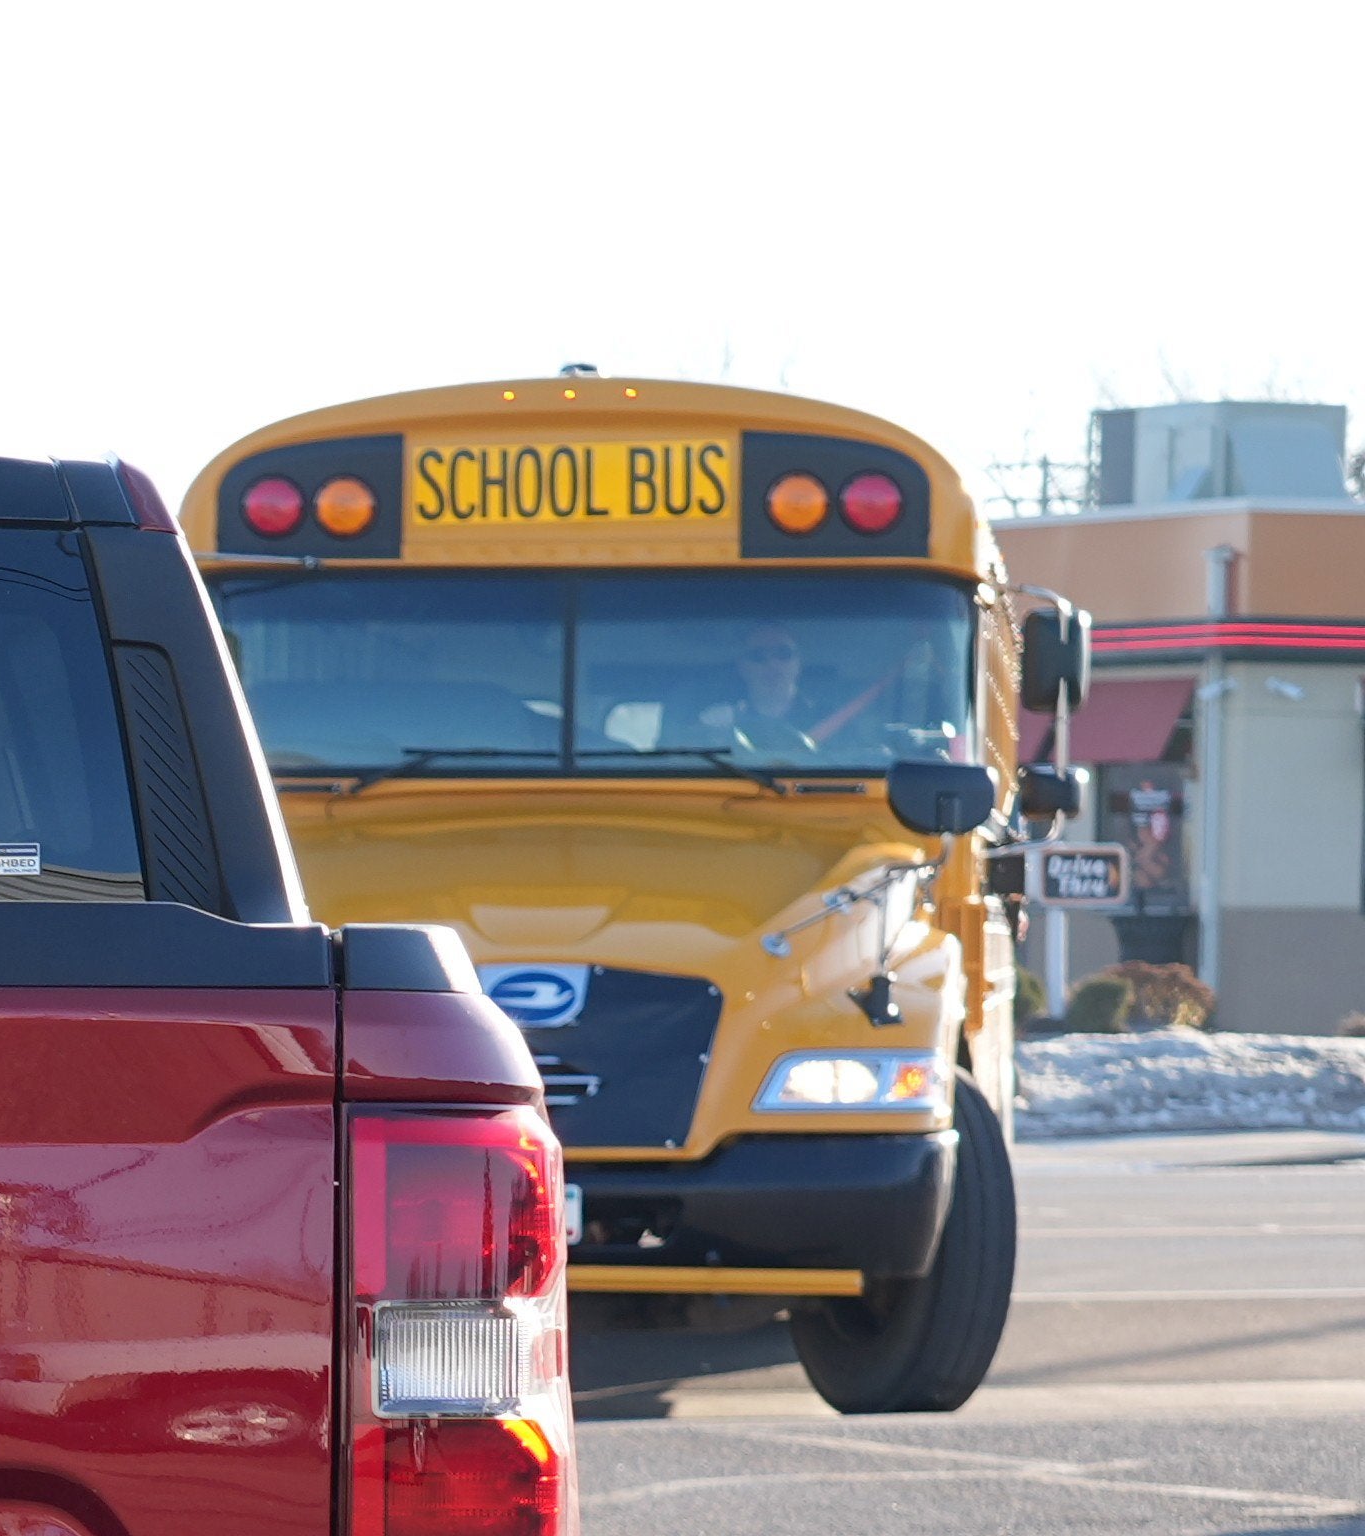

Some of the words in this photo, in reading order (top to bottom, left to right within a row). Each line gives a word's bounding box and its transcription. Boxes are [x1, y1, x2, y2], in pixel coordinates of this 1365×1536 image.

[417, 445, 609, 520] SCHOOL
[629, 444, 725, 515] BUS
[1048, 854, 1107, 878] Drive
[1057, 873, 1108, 898] Thru
